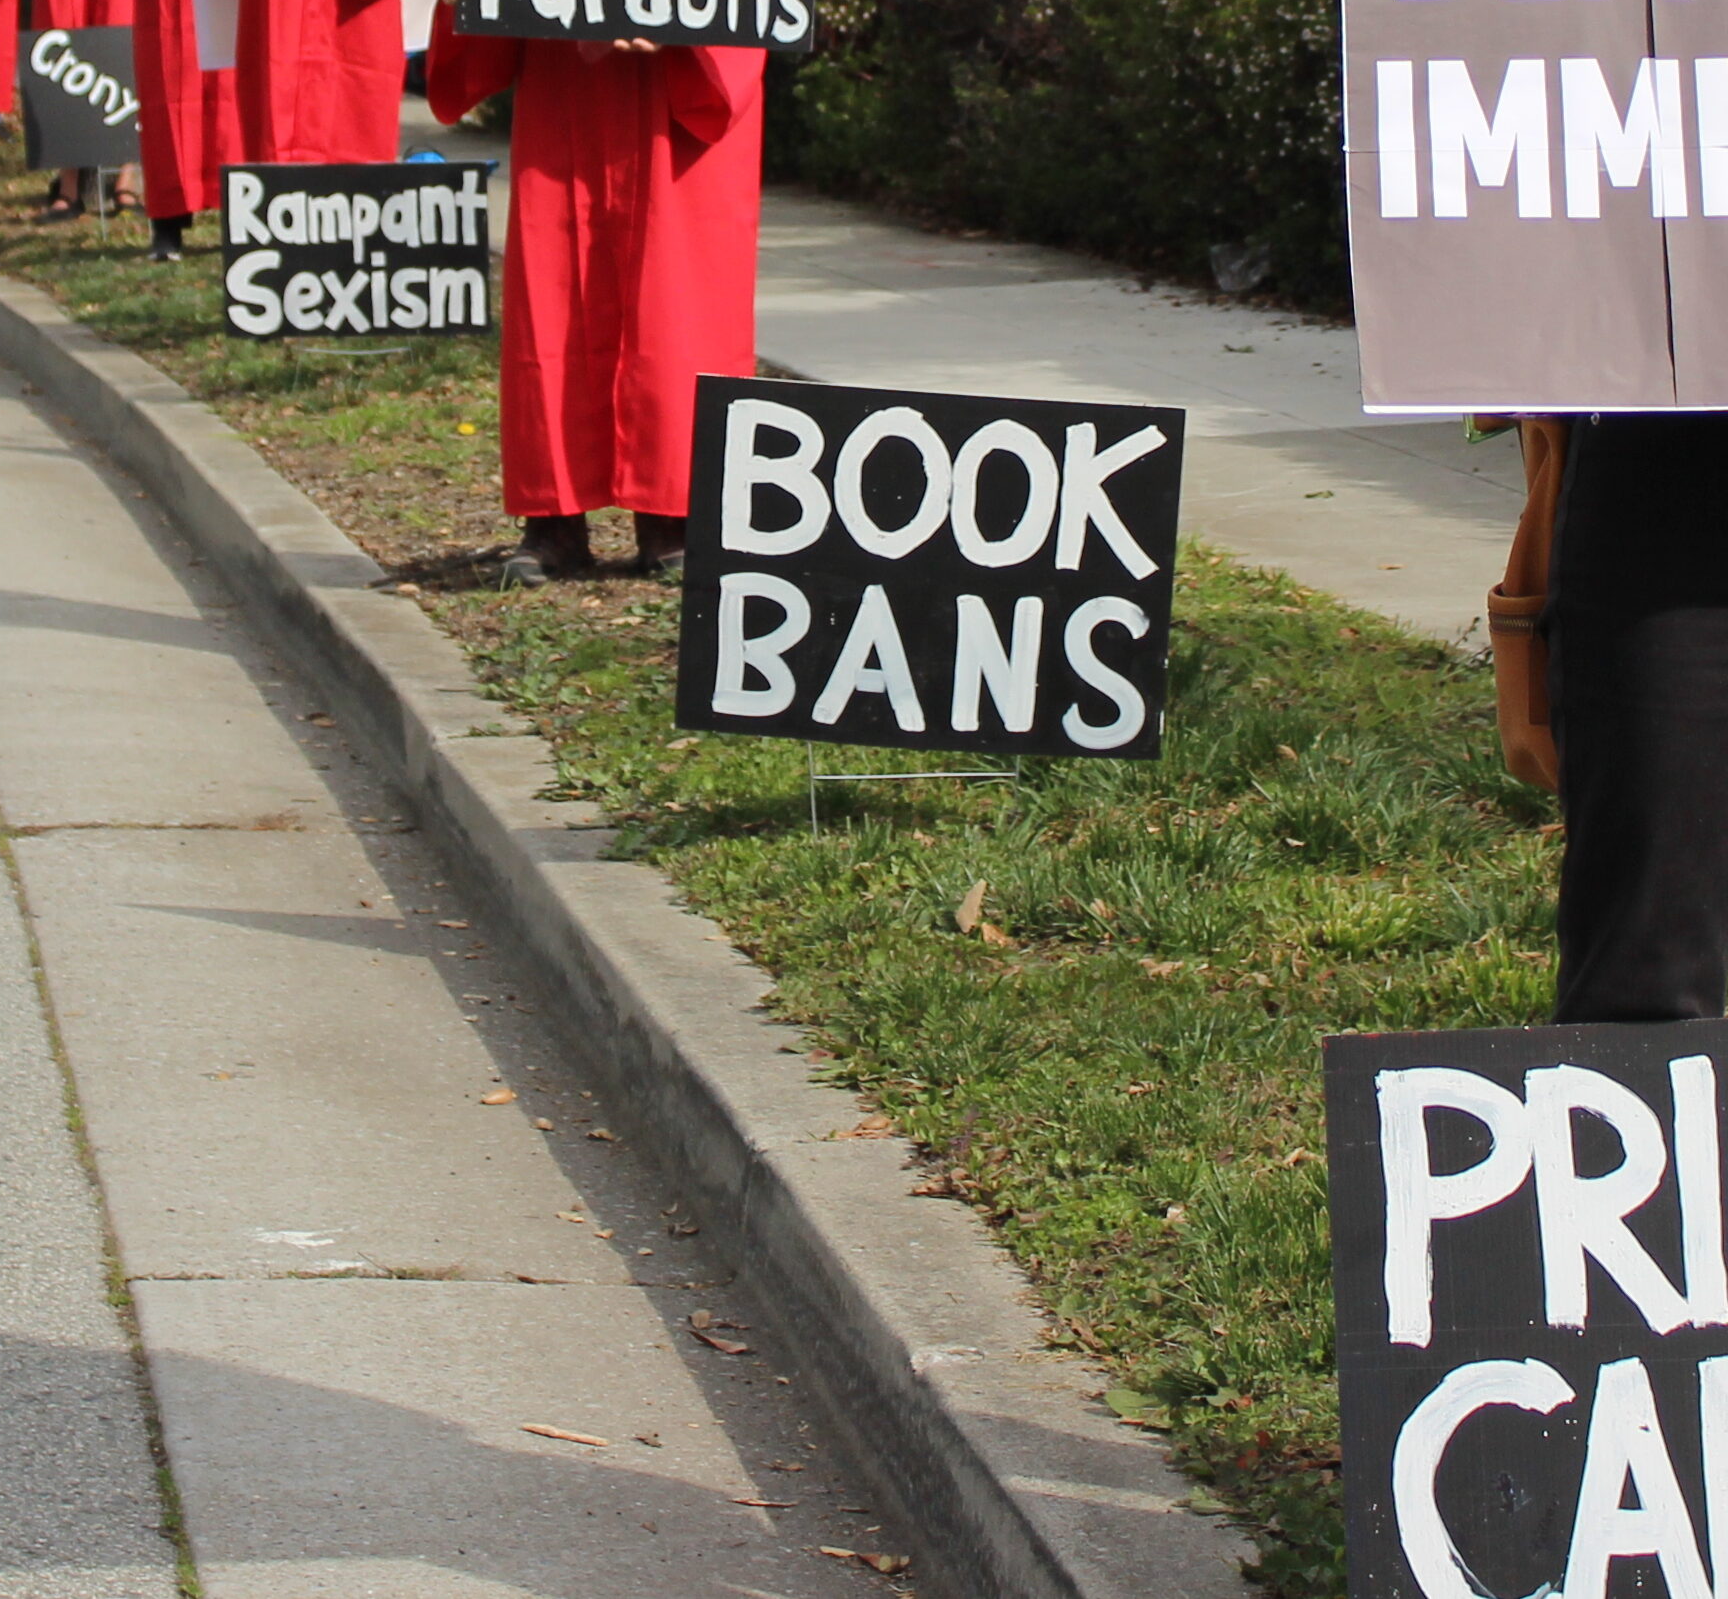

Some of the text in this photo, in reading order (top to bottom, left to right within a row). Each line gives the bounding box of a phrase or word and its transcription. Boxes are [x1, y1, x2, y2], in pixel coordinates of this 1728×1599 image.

[30, 29, 141, 126] Crony
[228, 170, 487, 264] Rampant
[225, 249, 486, 335] Sexism
[721, 398, 1167, 580] BOOK
[712, 571, 1149, 749] BANS
